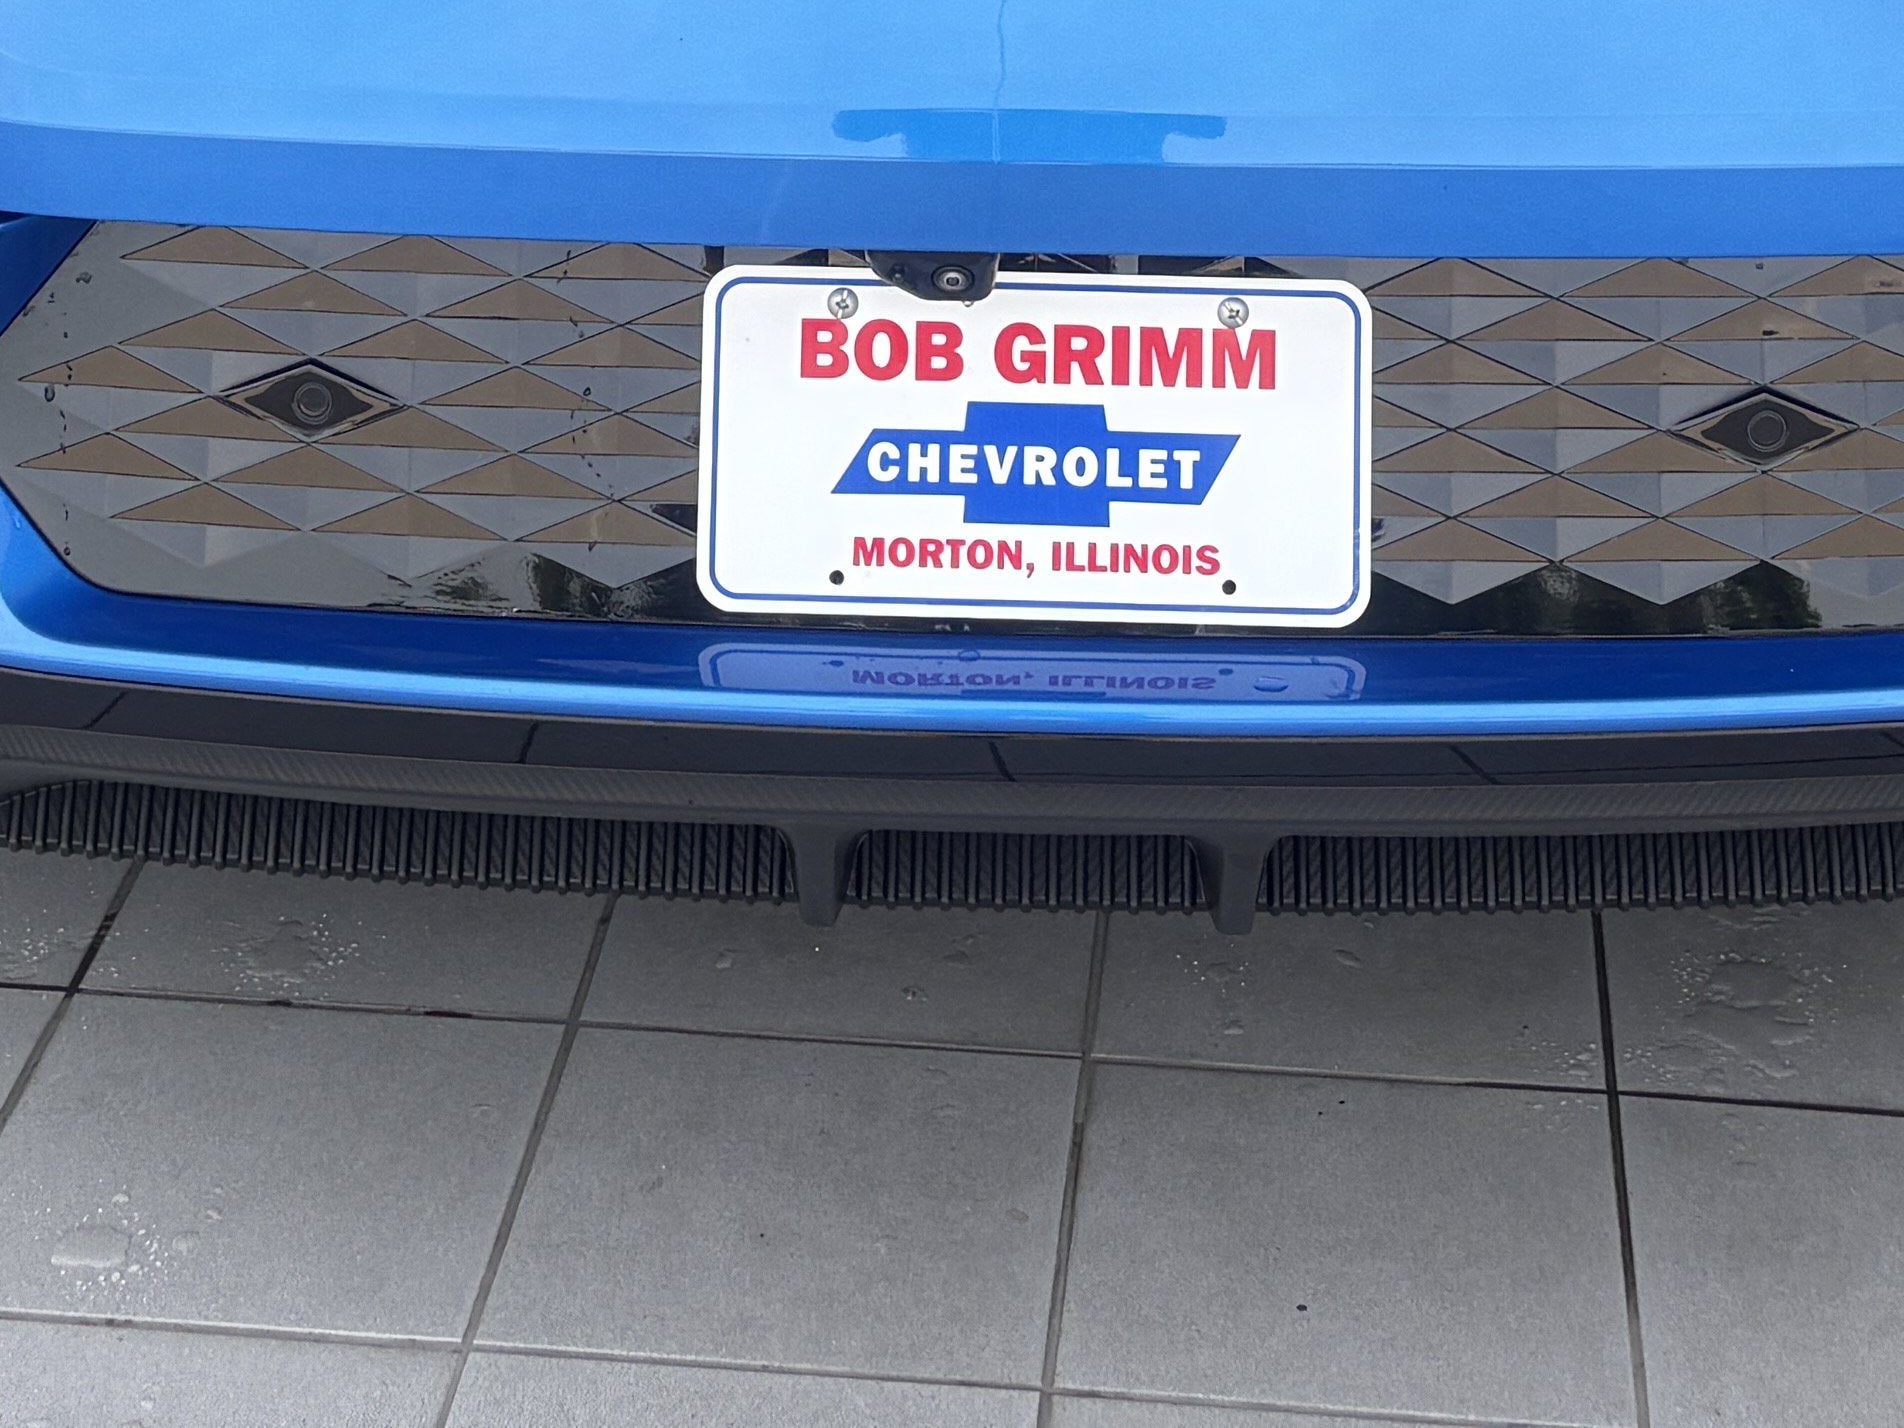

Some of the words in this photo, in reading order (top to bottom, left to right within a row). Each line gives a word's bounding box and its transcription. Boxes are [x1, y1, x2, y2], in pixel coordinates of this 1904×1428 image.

[799, 318, 965, 382] BOB
[993, 322, 1277, 391] GRIMM
[867, 441, 1202, 490] CHEVROLET
[851, 536, 1036, 579] MORTON,
[1051, 541, 1222, 577] ILLINOIS
